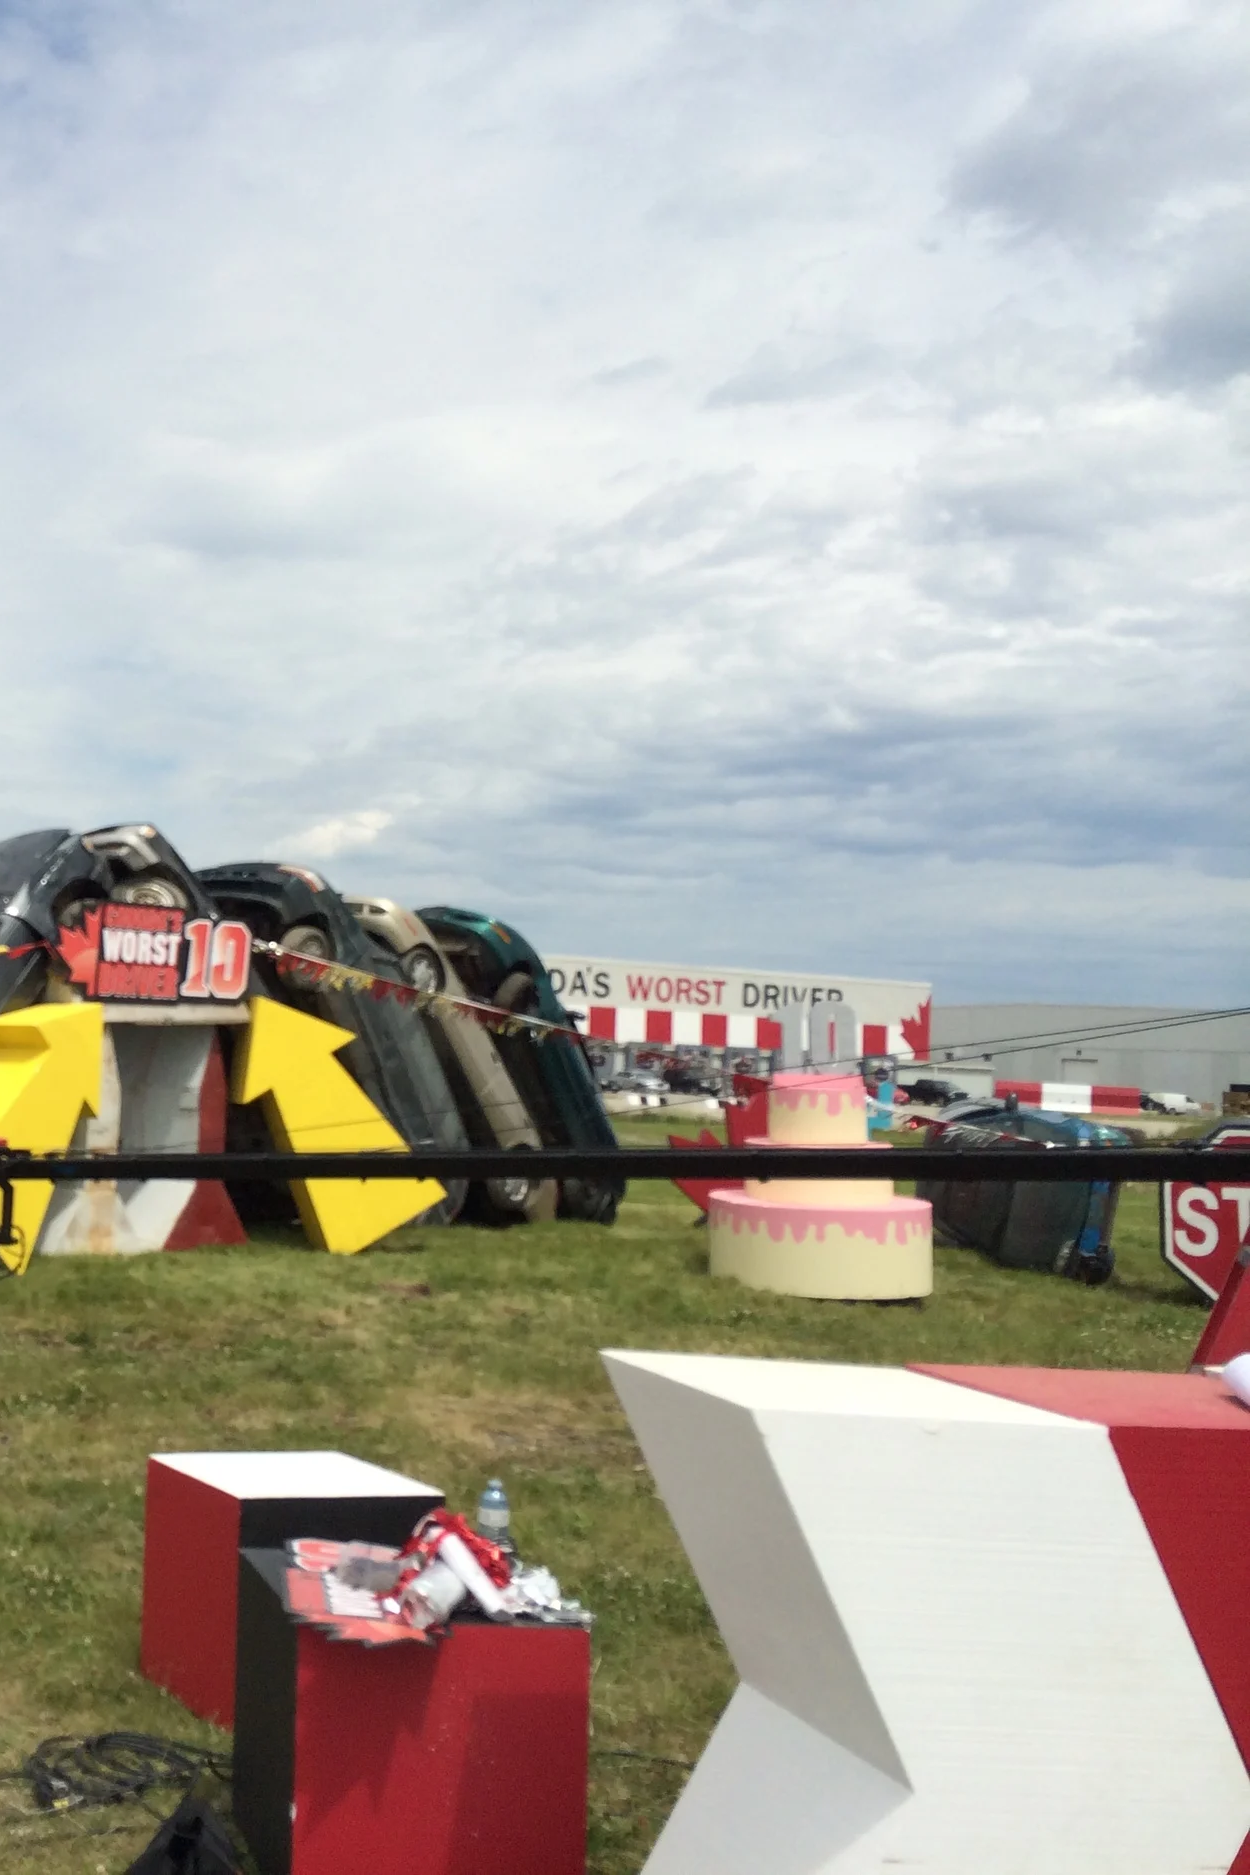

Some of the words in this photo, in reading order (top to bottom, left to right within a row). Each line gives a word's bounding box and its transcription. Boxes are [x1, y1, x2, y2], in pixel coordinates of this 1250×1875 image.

[102, 928, 182, 967] WORST
[179, 918, 252, 999] 10
[626, 975, 726, 1005] WORST
